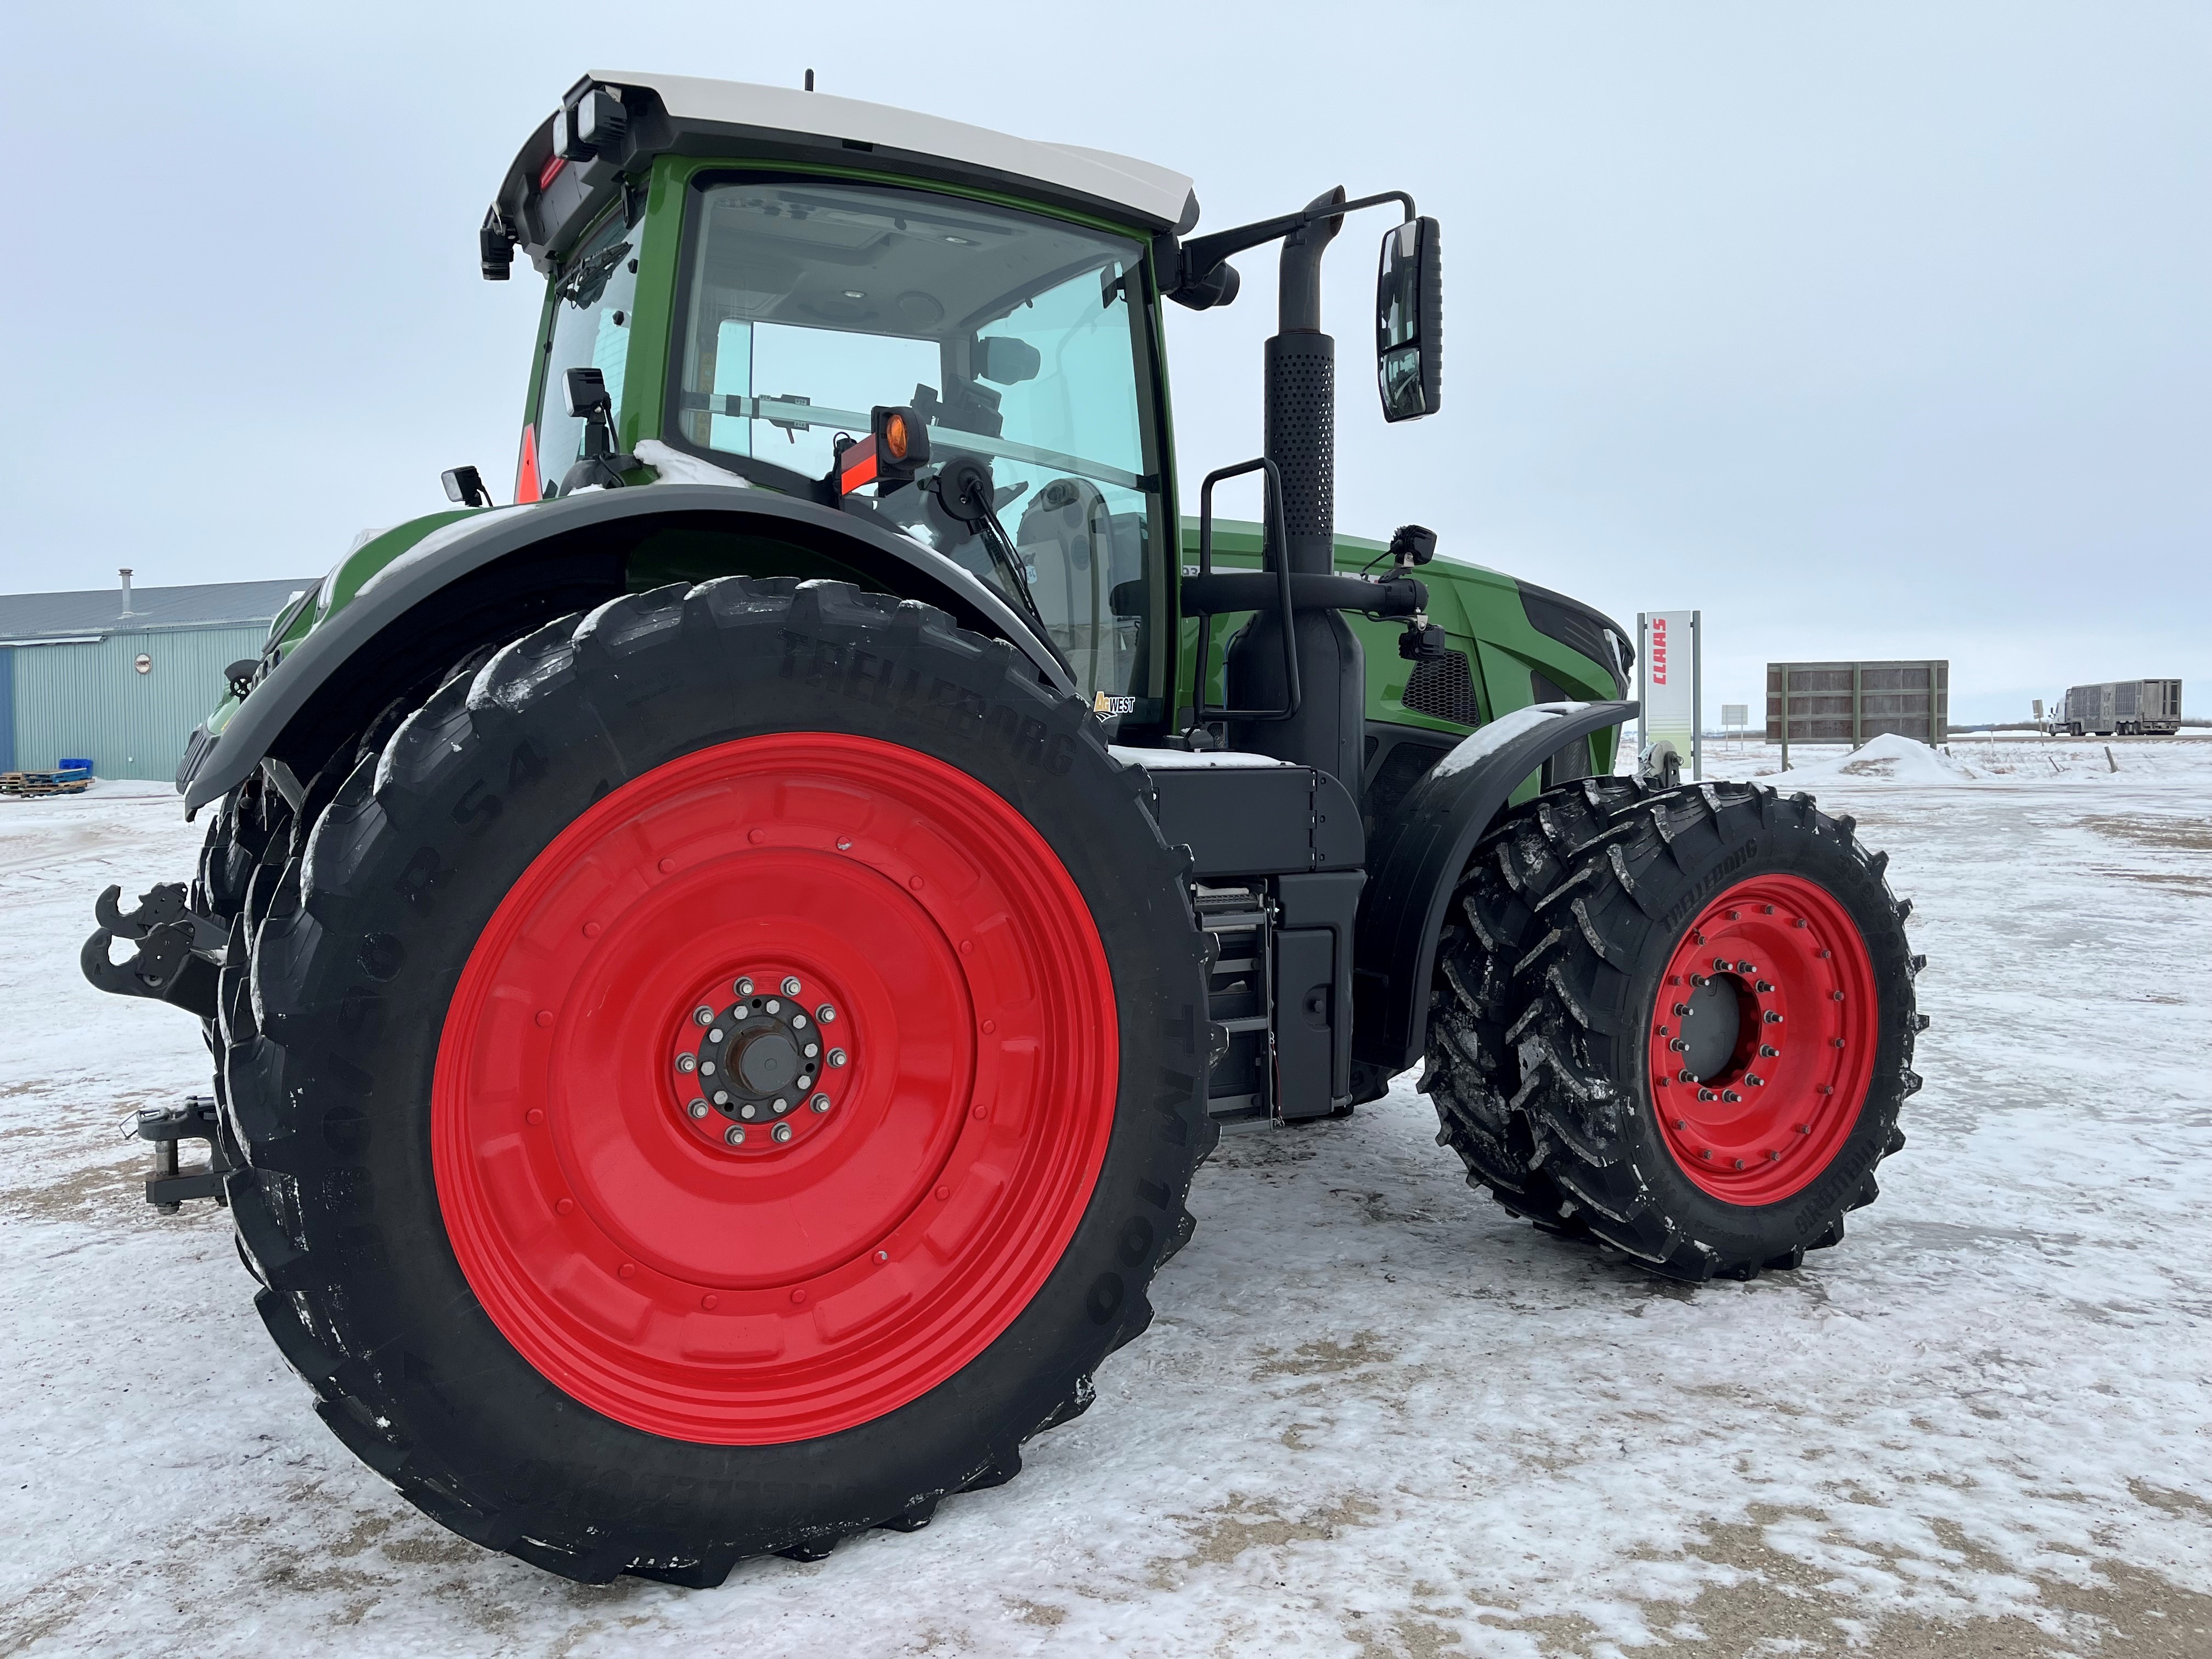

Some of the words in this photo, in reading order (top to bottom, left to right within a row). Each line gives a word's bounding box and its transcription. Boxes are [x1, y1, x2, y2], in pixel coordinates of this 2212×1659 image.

[1653, 618, 1666, 685] CLAAS
[777, 627, 1077, 776] TRELLEBORG
[1658, 837, 1757, 935] TRELLEBORG
